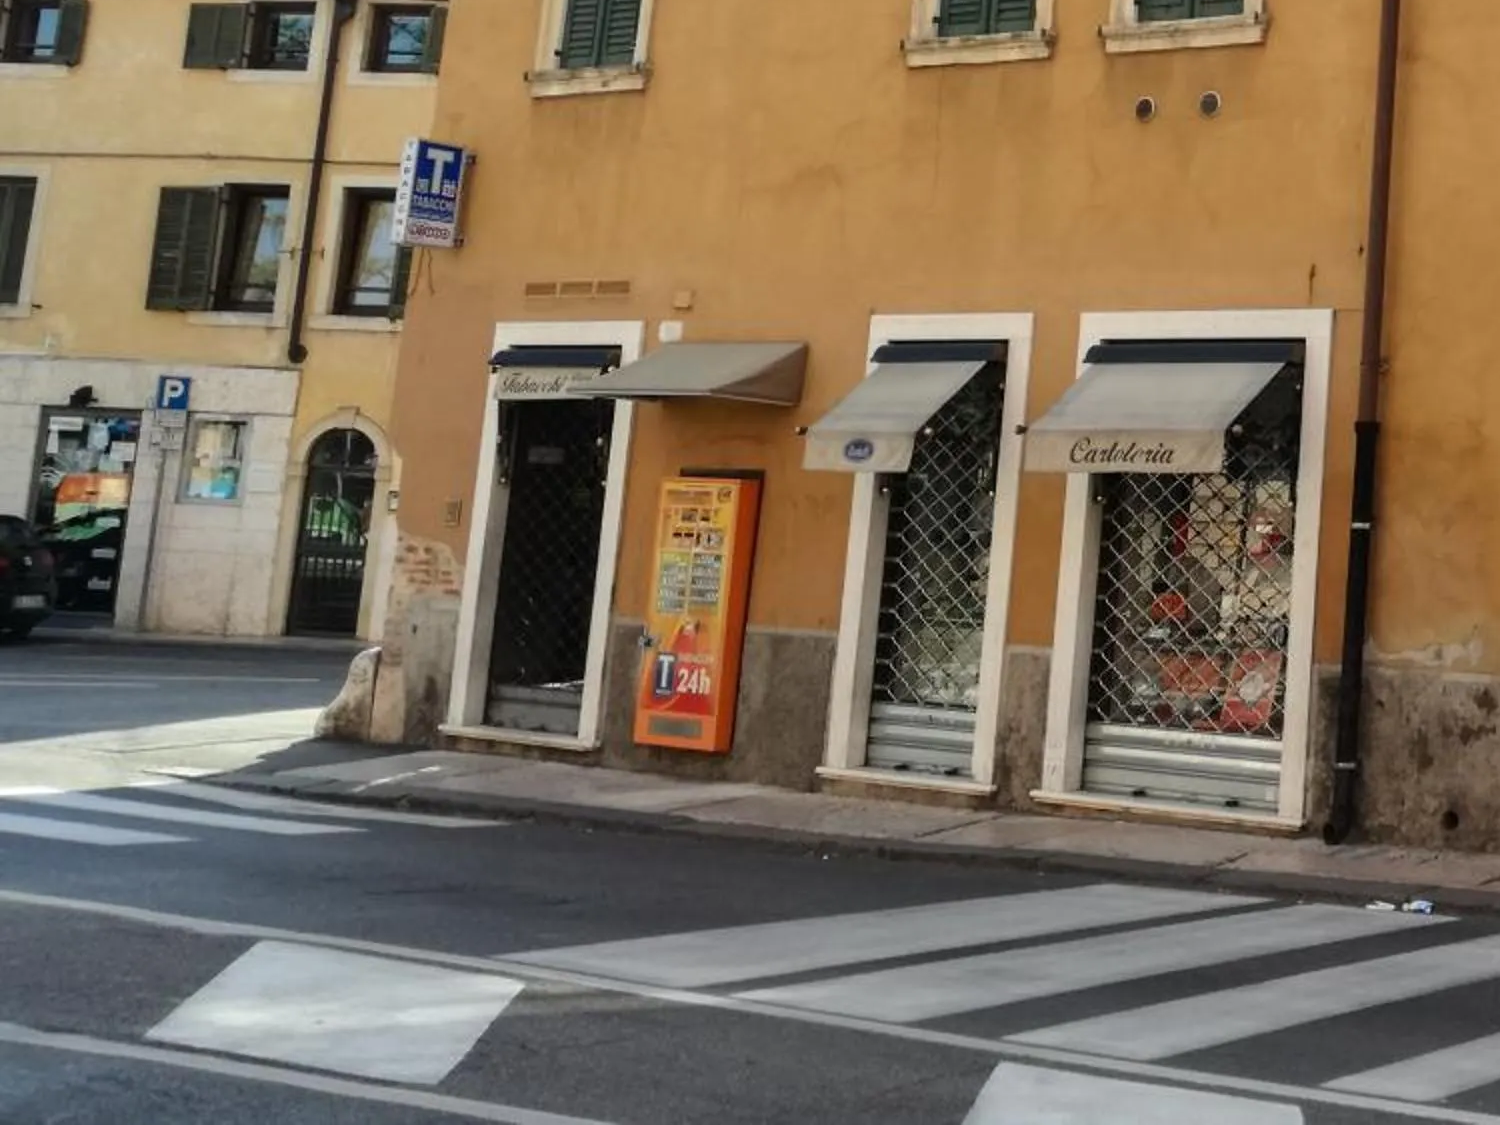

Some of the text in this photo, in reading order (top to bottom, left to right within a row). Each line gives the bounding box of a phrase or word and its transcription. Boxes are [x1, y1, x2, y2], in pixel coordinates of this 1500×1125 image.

[426, 147, 455, 194] T
[162, 378, 185, 407] P
[1069, 436, 1174, 464] Cartoleria
[676, 667, 711, 695] 24h
